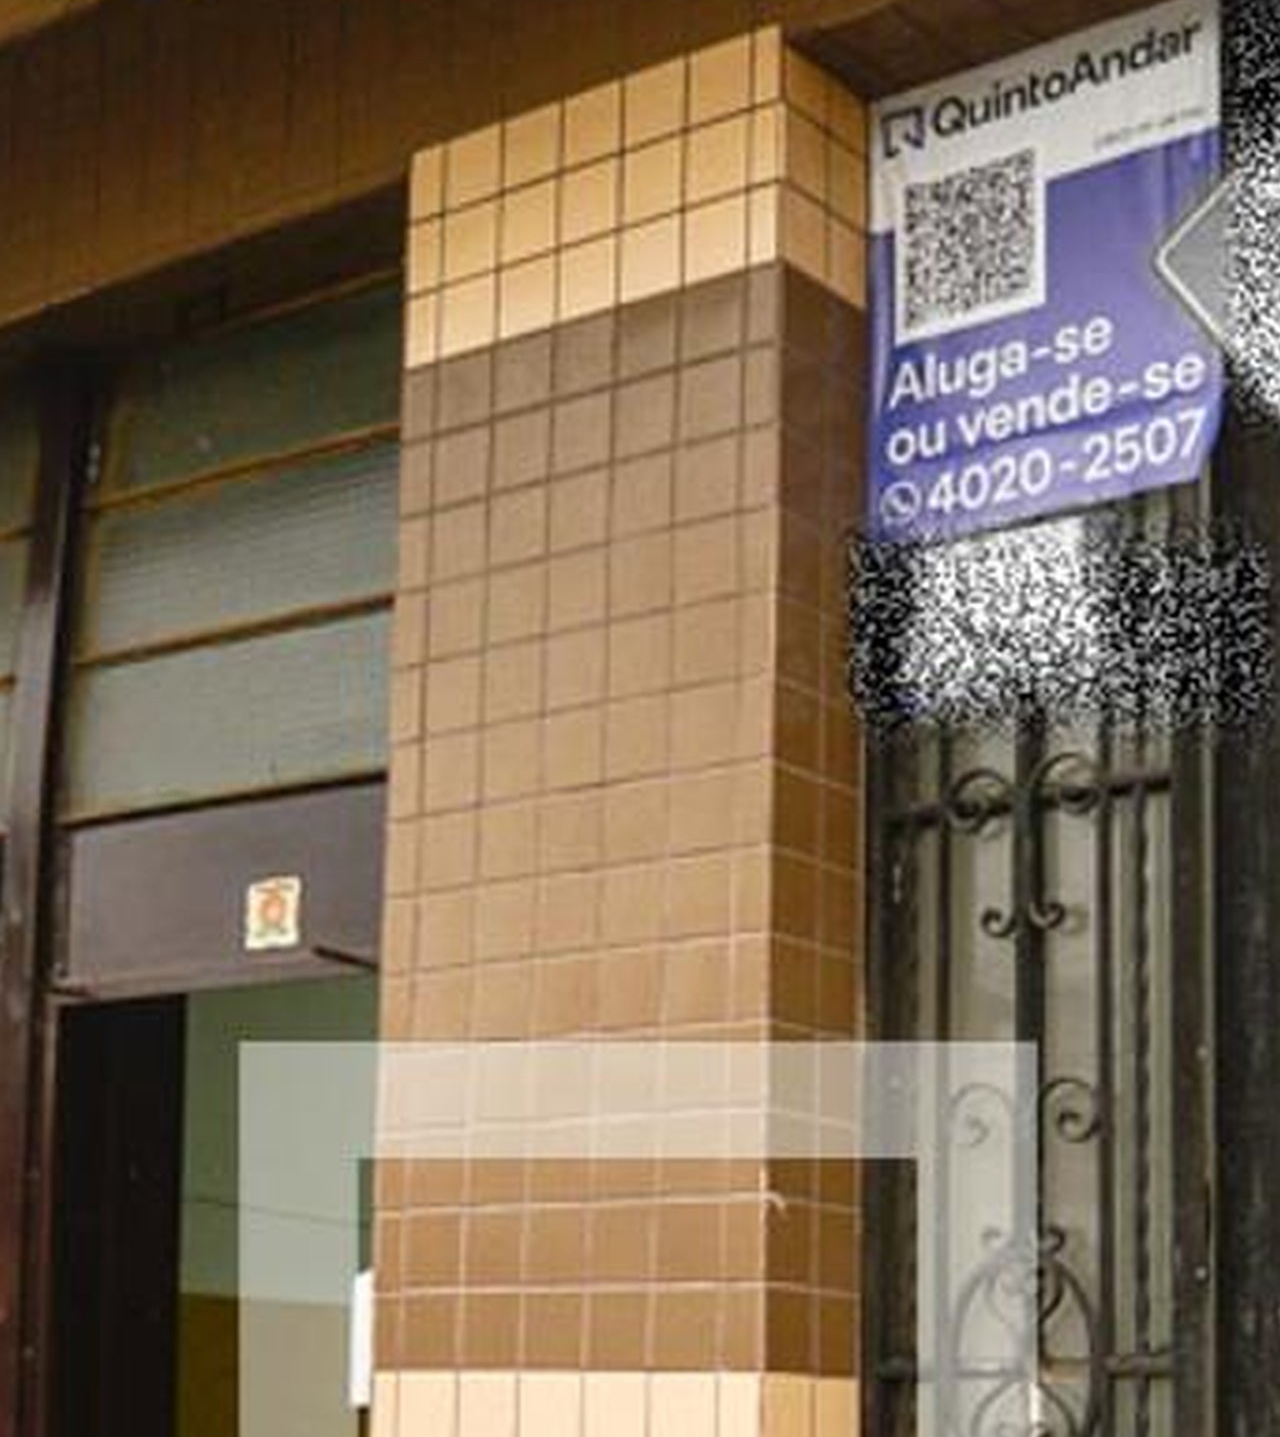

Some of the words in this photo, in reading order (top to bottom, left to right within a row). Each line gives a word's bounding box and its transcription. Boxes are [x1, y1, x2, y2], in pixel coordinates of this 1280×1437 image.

[930, 20, 1202, 139] QuintoAndar
[886, 421, 947, 465] ou
[957, 353, 1207, 449] vende-se
[888, 316, 1113, 409] Aluga-se
[927, 407, 1208, 514] 4020-2507
